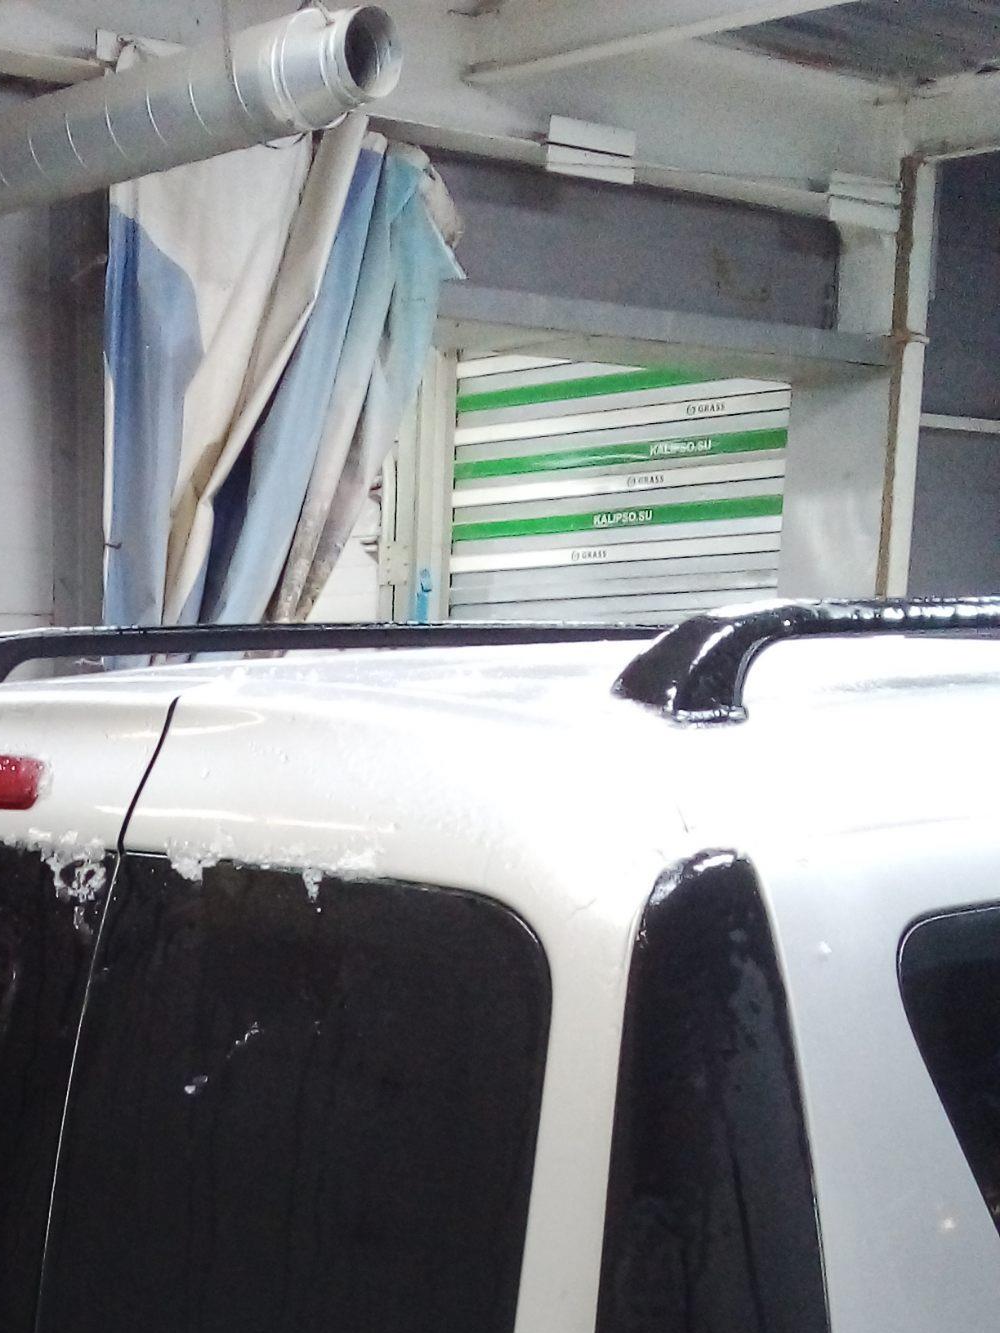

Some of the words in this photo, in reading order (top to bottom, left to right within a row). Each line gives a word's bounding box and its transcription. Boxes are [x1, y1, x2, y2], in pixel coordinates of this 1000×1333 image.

[697, 403, 726, 413] GRASS
[649, 438, 712, 456] KALIPSO.SU
[638, 474, 664, 485] GRASS
[593, 509, 653, 526] KALIPSO.SU
[581, 550, 607, 560] GRASS
